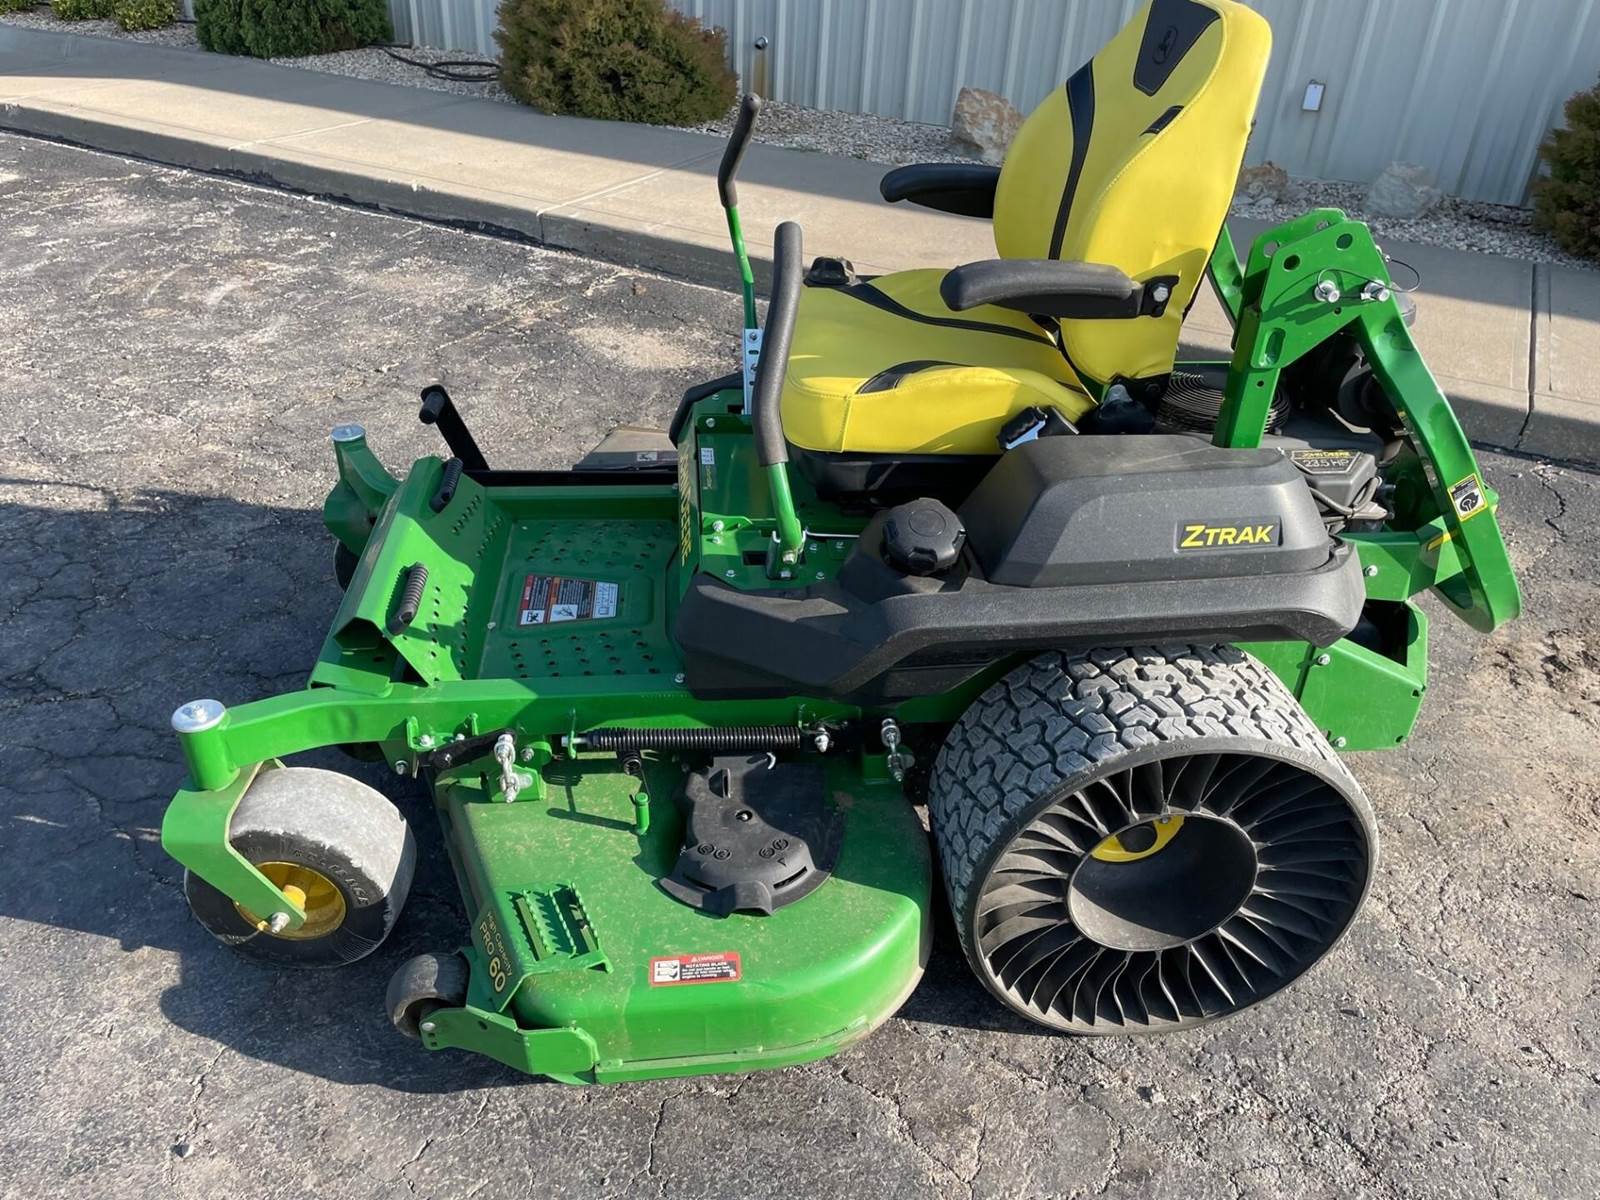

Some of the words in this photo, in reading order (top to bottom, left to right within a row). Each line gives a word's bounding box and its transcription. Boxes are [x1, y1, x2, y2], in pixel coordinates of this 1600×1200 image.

[1331, 459, 1350, 467] HP
[681, 495, 692, 568] DEERE
[1180, 524, 1274, 548] ZTRAK
[480, 921, 495, 955] PRO
[489, 956, 506, 992] 60
[495, 932, 513, 977] Capacity
